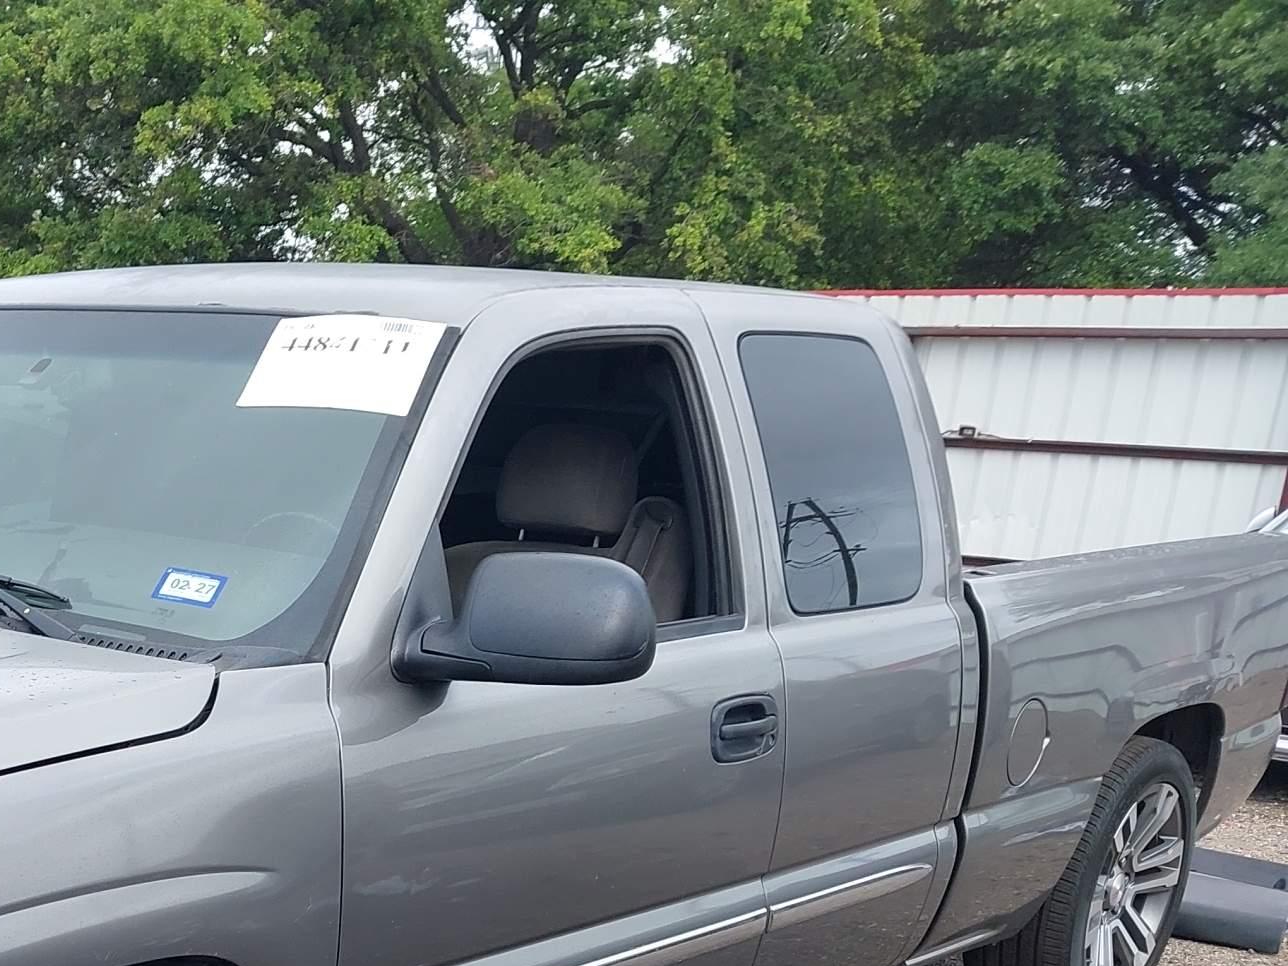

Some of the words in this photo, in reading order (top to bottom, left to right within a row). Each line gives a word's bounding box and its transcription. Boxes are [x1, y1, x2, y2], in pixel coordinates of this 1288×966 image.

[281, 336, 411, 355] 448111
[170, 578, 190, 591] 02
[195, 582, 216, 595] 27
